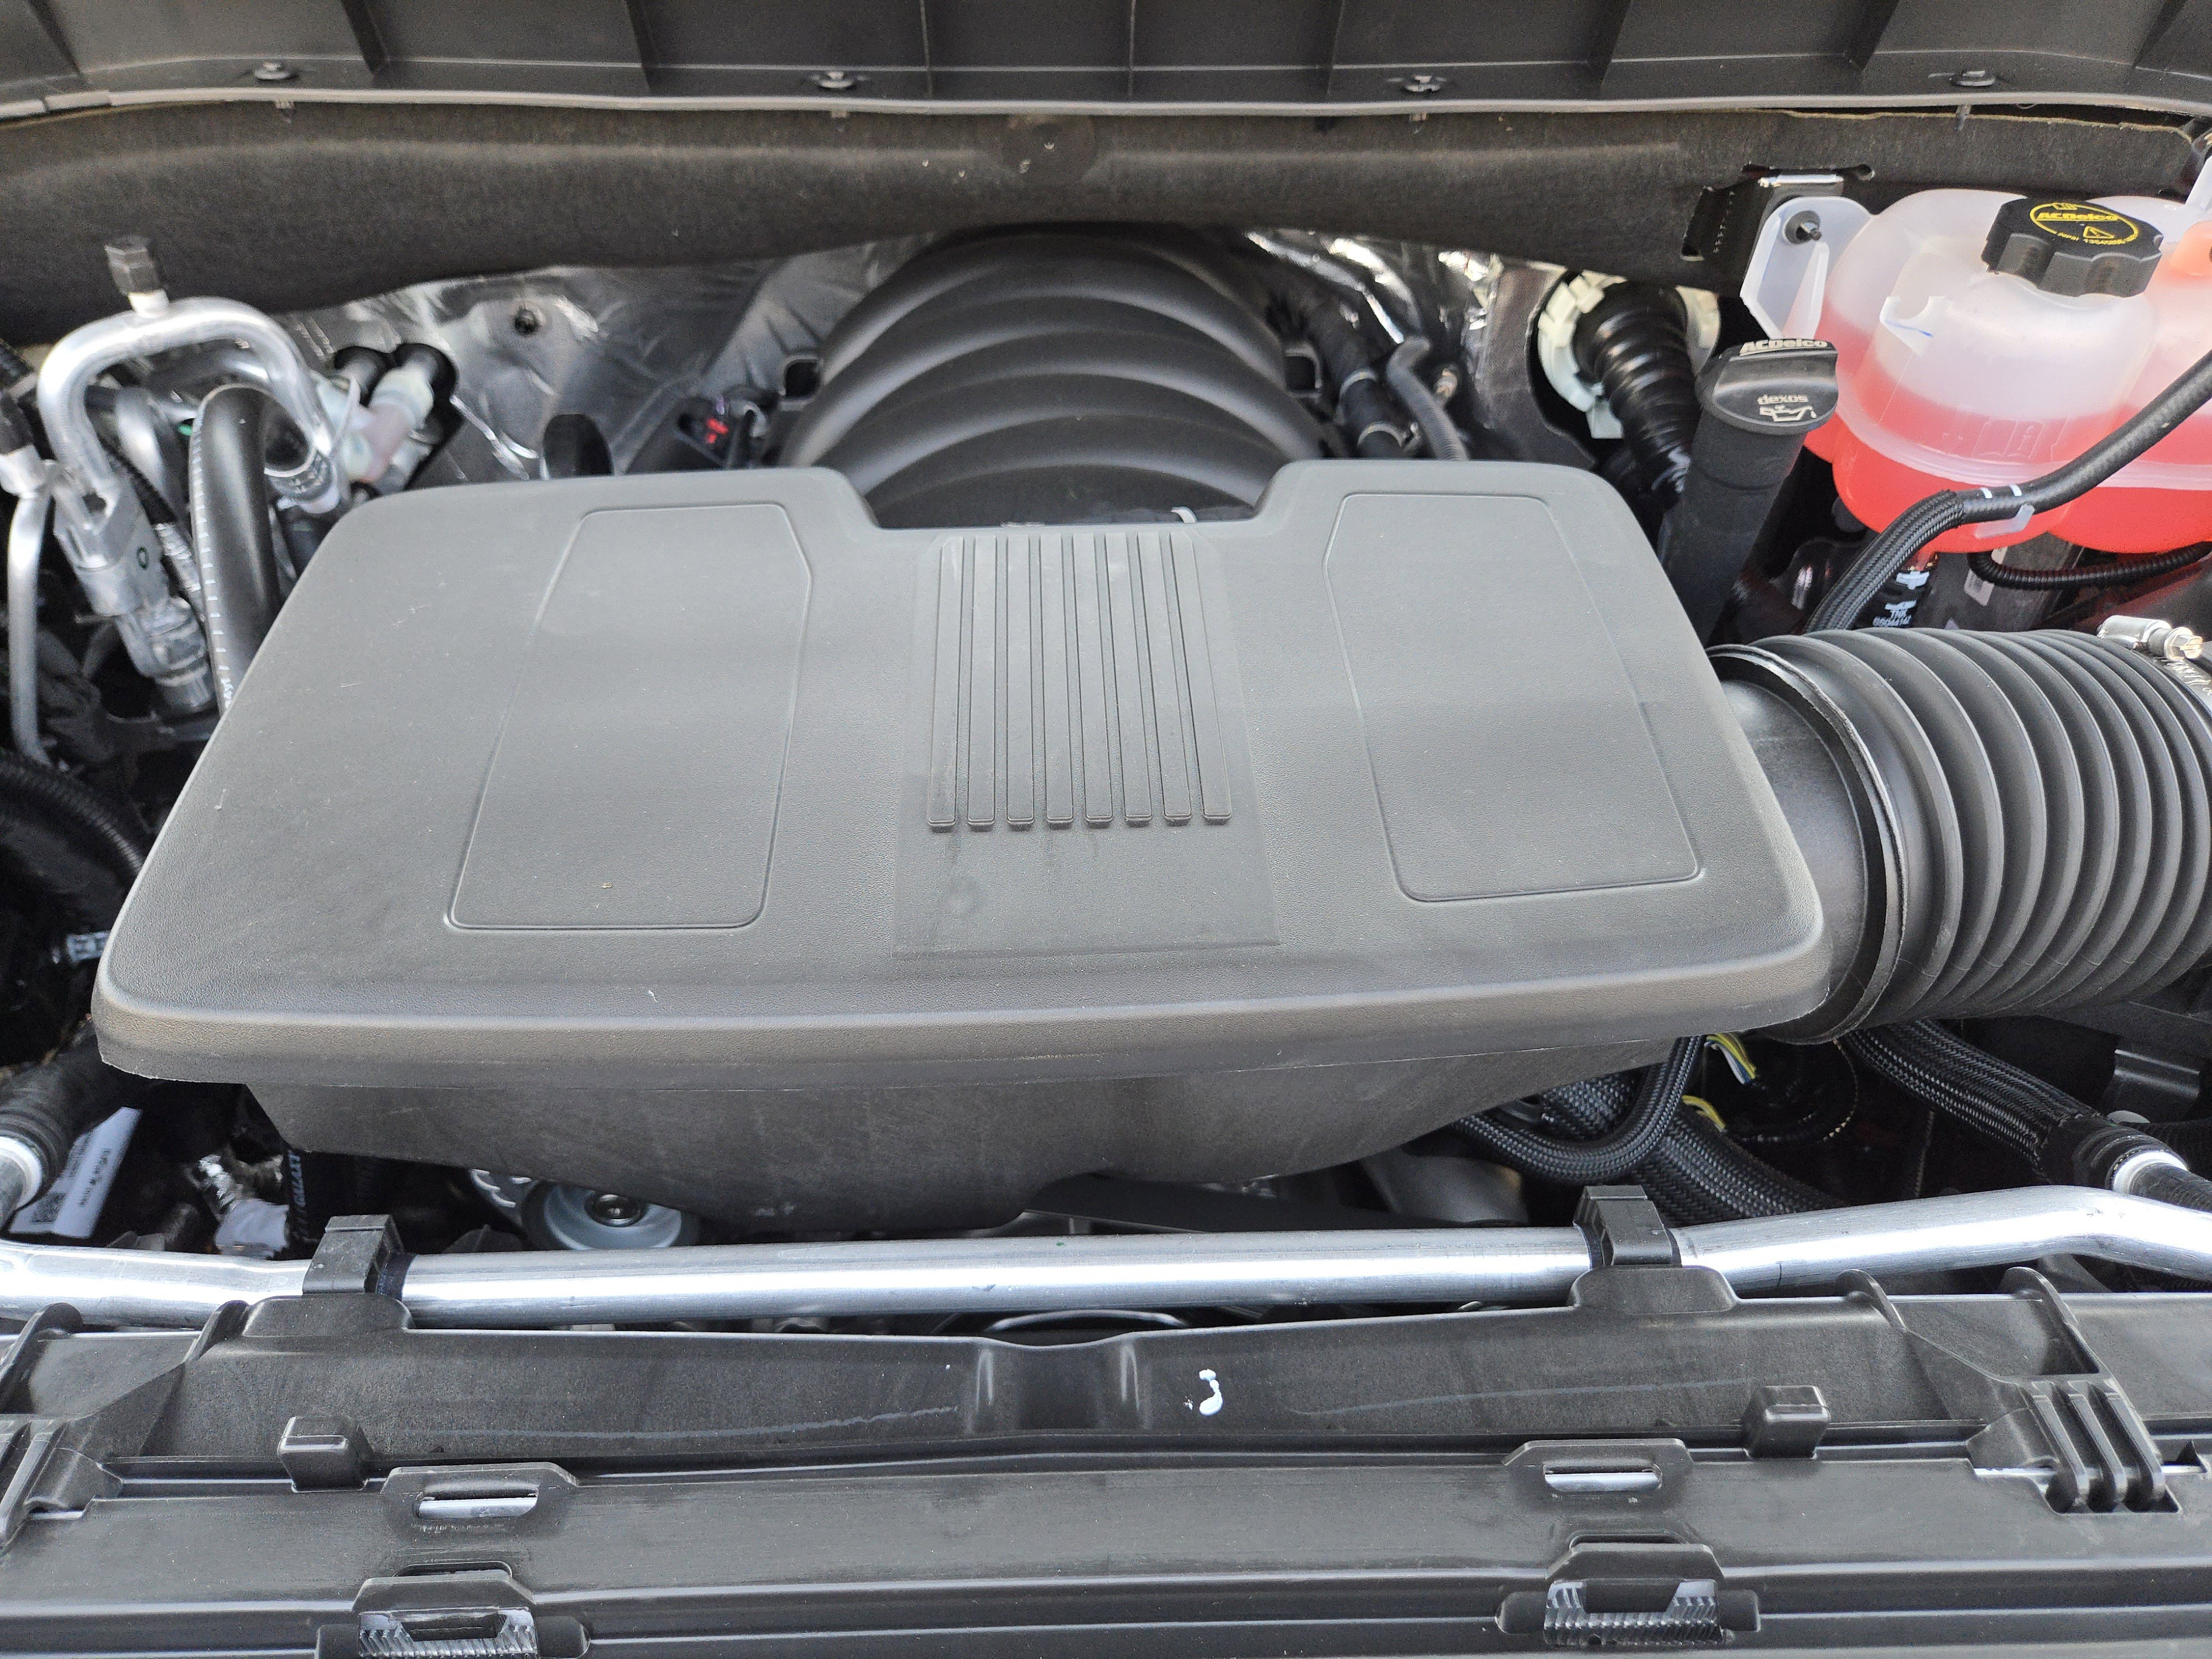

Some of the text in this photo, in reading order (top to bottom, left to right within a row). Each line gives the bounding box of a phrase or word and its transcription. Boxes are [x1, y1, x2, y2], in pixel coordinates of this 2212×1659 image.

[2036, 212, 2117, 221] ACDelco
[1739, 338, 1828, 354] ACDelco
[1757, 394, 1808, 405] dexos
